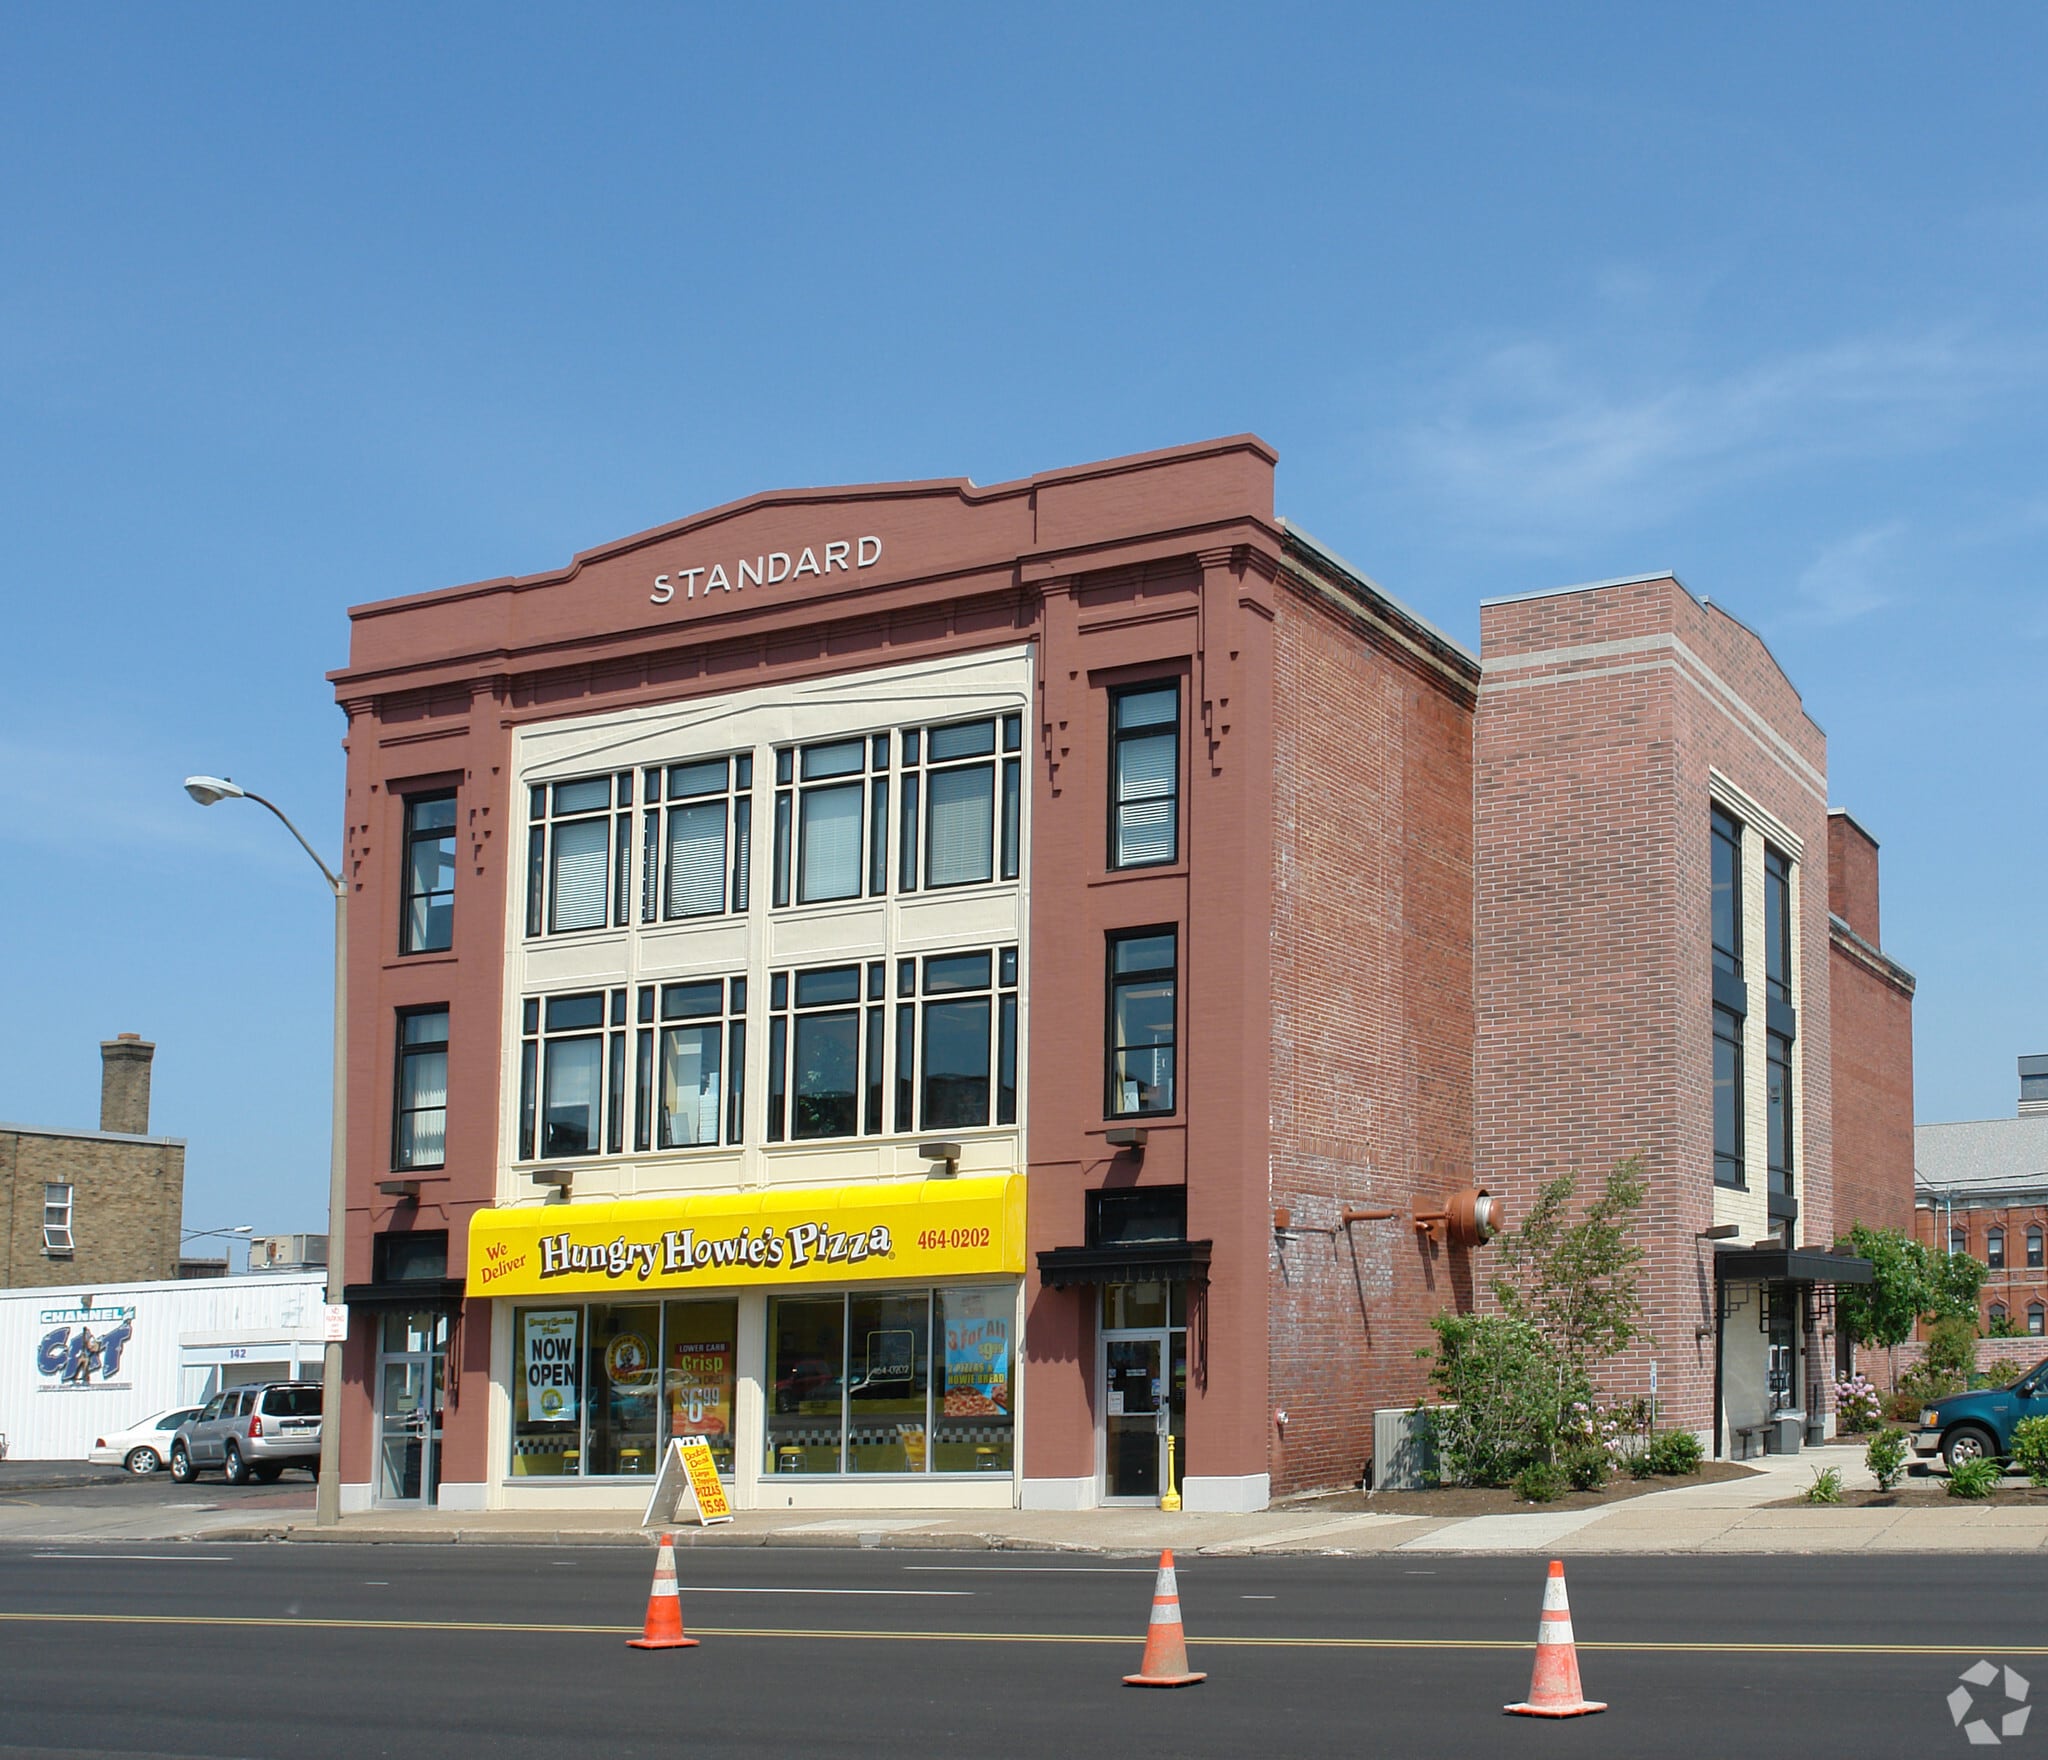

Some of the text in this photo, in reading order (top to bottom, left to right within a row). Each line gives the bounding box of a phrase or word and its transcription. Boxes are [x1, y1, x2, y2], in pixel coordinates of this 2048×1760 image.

[650, 536, 882, 604] STANDARD
[917, 1228, 990, 1250] 464-0202
[485, 1242, 508, 1262] We
[539, 1221, 892, 1281] Hungry Howie's Pizza
[481, 1254, 527, 1284] Deliver
[41, 1308, 122, 1323] CHANNEL
[948, 1319, 1006, 1351] 3 For All
[230, 1349, 247, 1359] 142
[532, 1338, 571, 1361] NOW
[679, 1343, 726, 1353] LOWER CARB
[681, 1354, 724, 1374] Crisp
[528, 1363, 575, 1387] OPEN
[948, 1373, 1005, 1384] HOWIE BREAD
[684, 1447, 708, 1461] Double
[690, 1455, 709, 1468] Deal
[695, 1485, 721, 1497] PIZZAS
